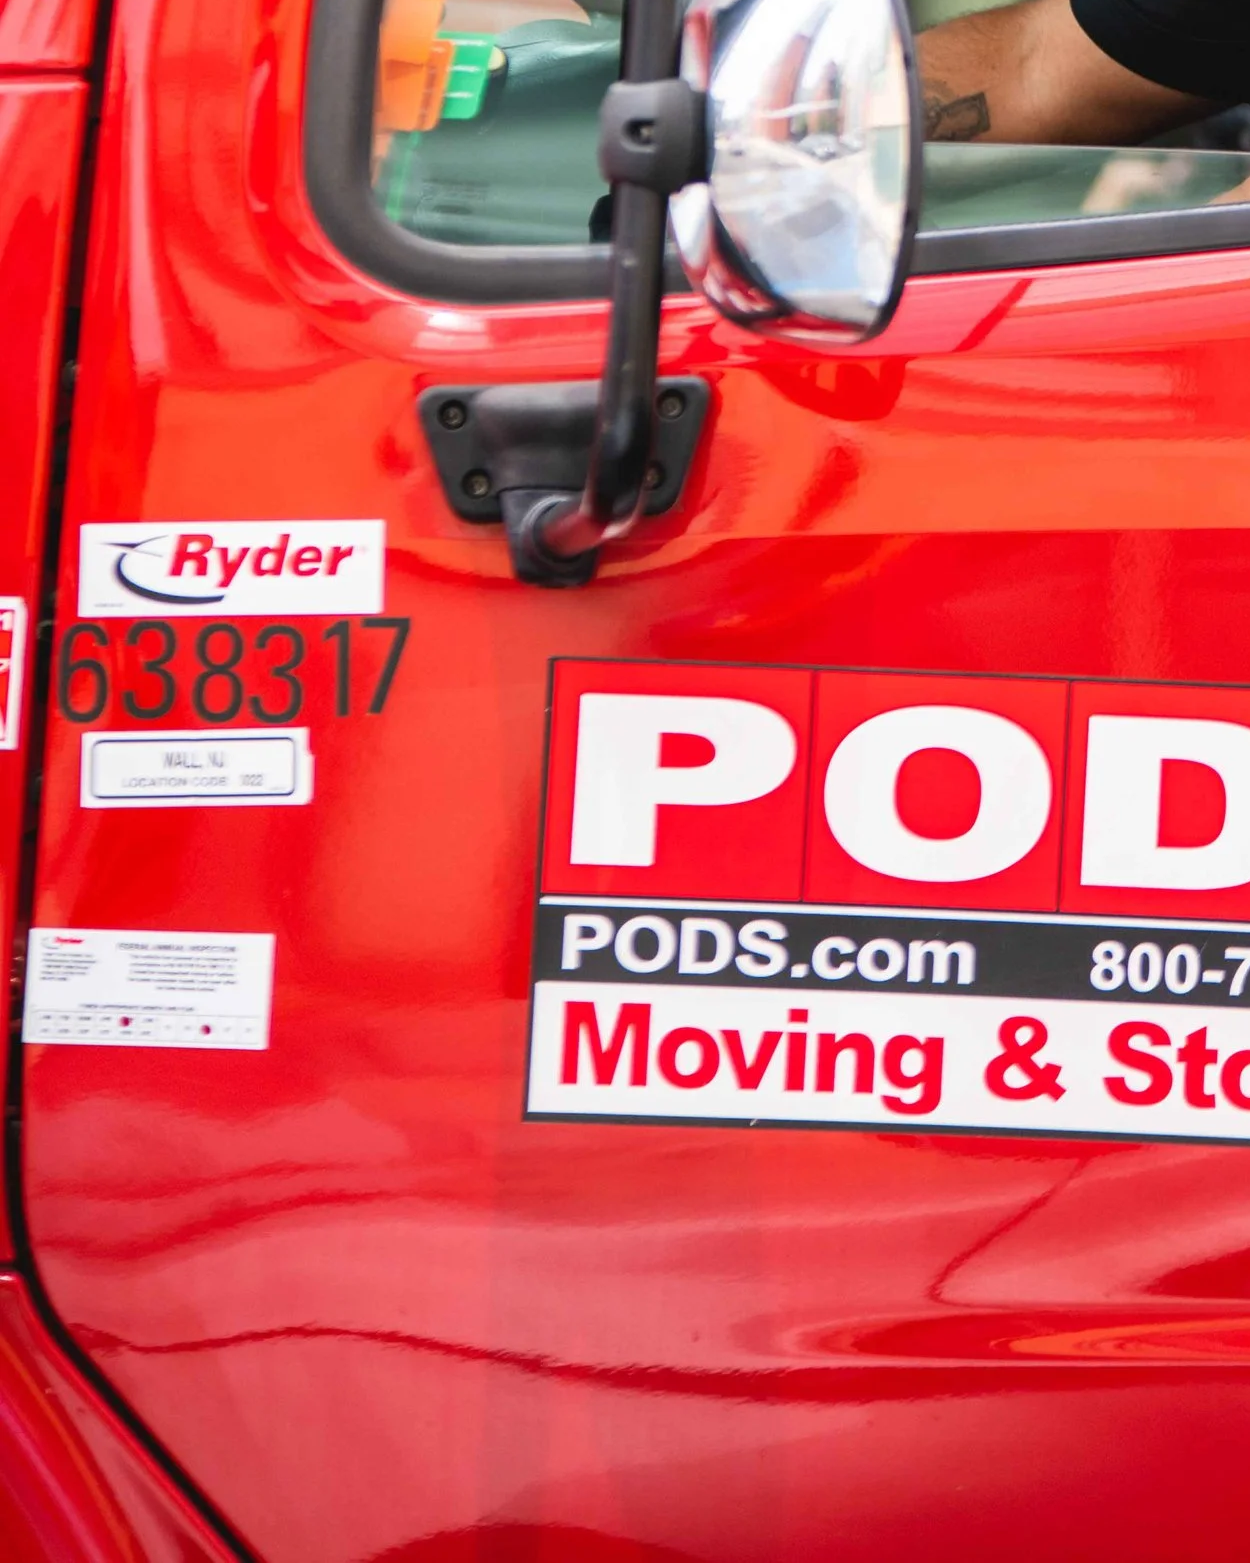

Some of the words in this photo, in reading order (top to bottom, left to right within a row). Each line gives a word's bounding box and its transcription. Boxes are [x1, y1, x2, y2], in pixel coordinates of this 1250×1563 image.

[167, 533, 354, 589] Ryder
[57, 617, 411, 724] 638317
[561, 913, 976, 985] PODS.com
[560, 1000, 945, 1116] Moving
[983, 1015, 1067, 1102] &
